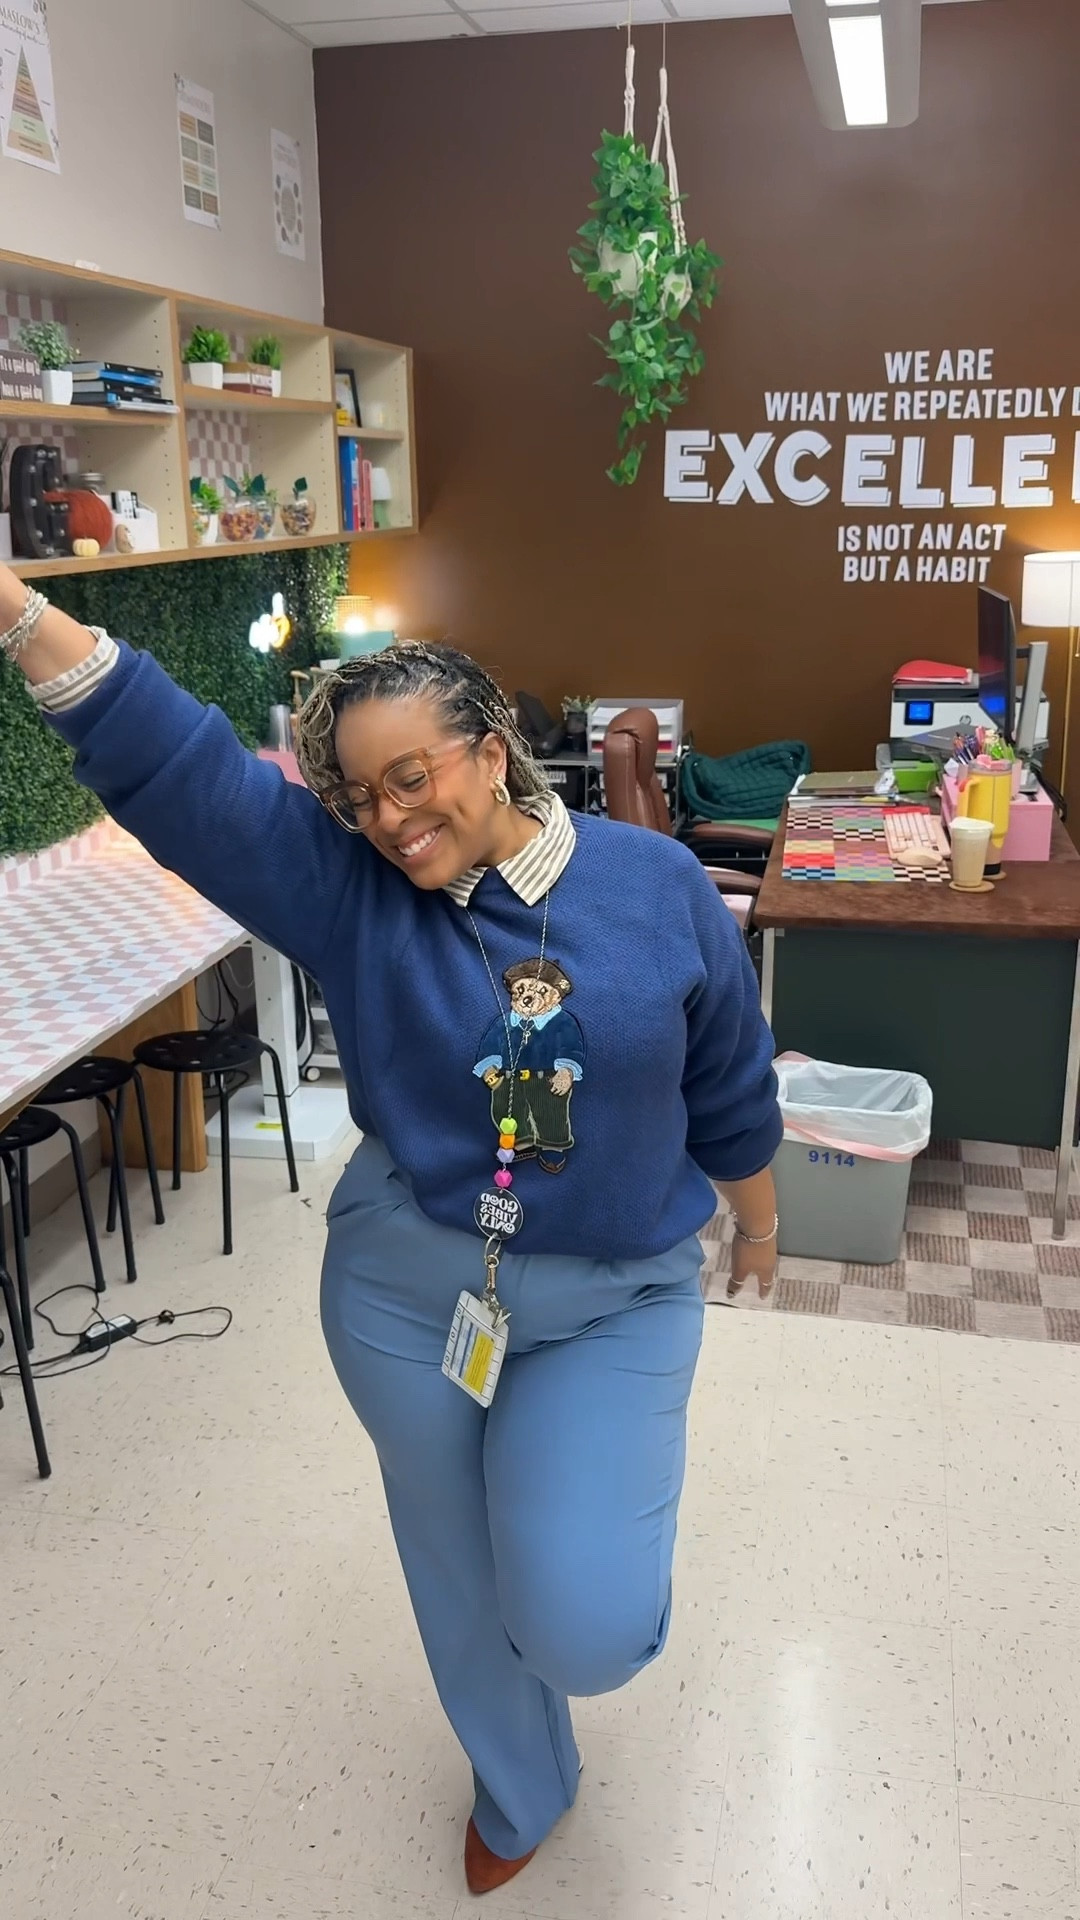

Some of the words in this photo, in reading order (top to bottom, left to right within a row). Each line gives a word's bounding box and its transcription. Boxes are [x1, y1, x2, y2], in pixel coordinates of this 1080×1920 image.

[884, 351, 930, 384] WE
[935, 348, 994, 382] ARE
[764, 392, 841, 422] WHAT
[846, 392, 888, 422] WE
[894, 387, 1067, 421] REPEATEDLY
[663, 430, 1080, 509] EXCELLE
[837, 525, 861, 552] IS
[866, 524, 914, 551] NOT
[918, 523, 953, 550] AN
[956, 523, 1007, 551] ACT
[843, 556, 891, 582] BUT
[893, 556, 910, 582] A
[916, 556, 991, 583] HABIT
[808, 1150, 855, 1168] 9114
